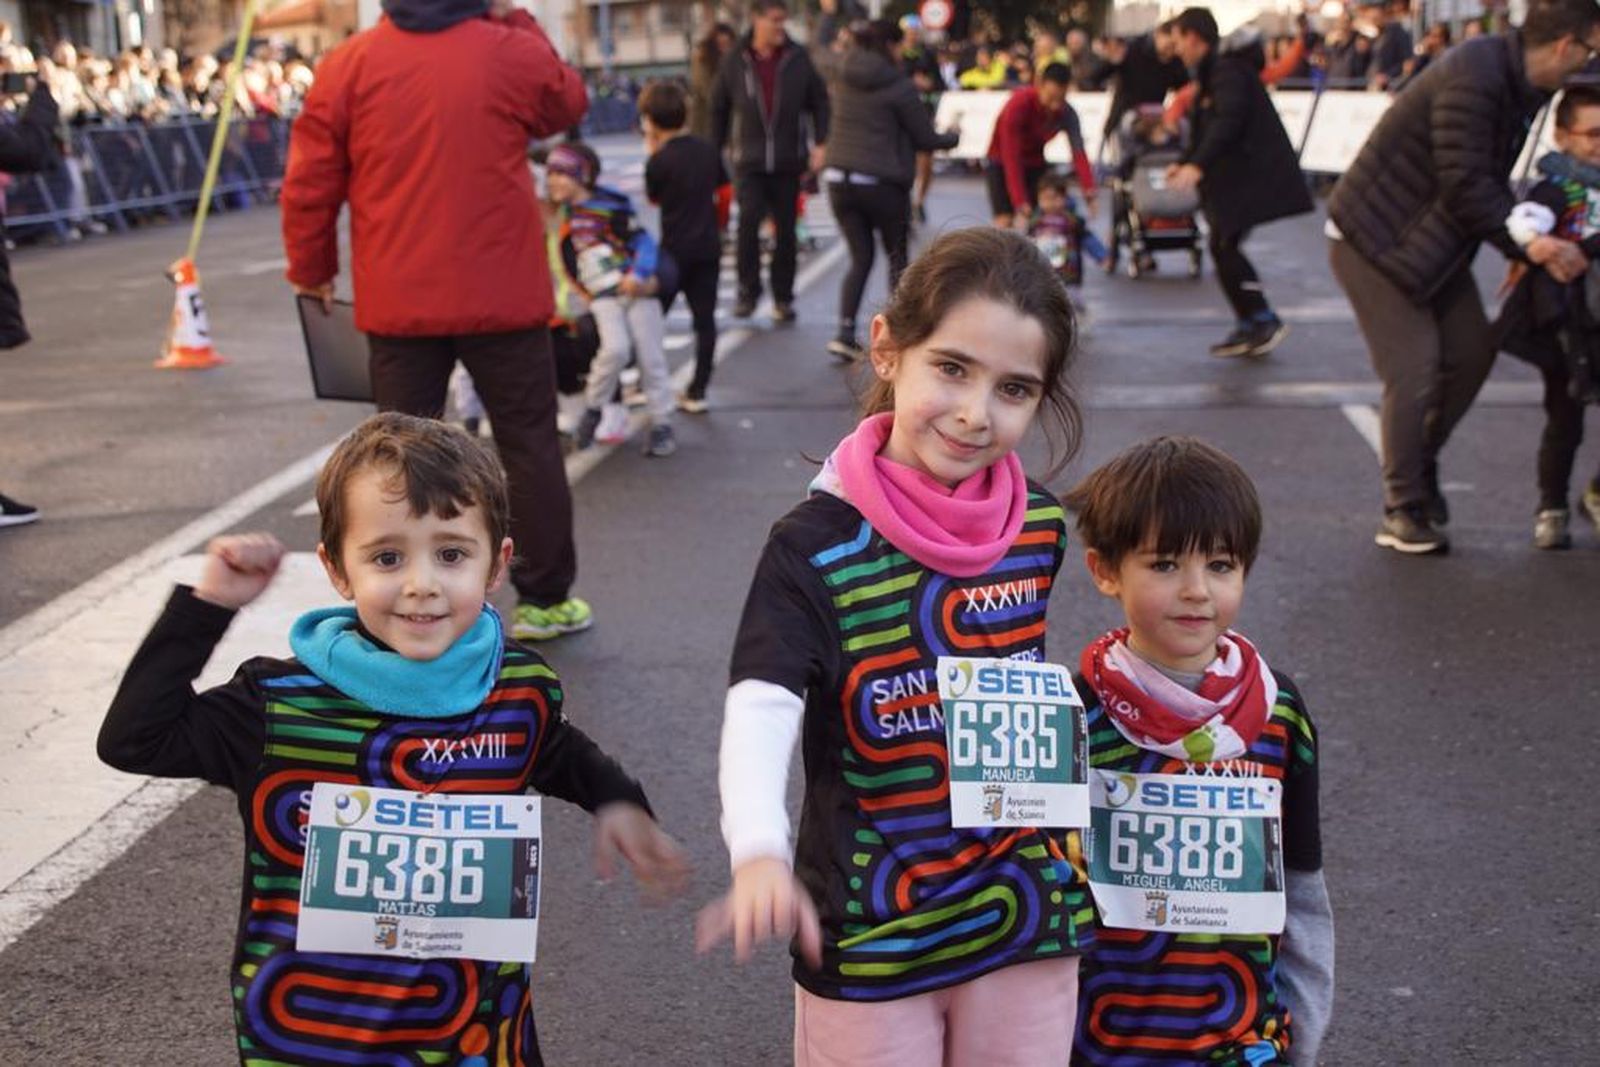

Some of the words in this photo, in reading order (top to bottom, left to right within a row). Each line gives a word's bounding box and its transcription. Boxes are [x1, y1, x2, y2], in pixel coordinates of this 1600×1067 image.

[962, 578, 1038, 613] XXXVIII
[871, 670, 928, 704] SAN
[977, 667, 1073, 698] SETEL
[952, 701, 1059, 769] 6385
[981, 766, 1035, 782] MANUELA
[1140, 781, 1265, 810] SETEL
[374, 798, 519, 831] SETEL
[1108, 812, 1244, 879] 6388
[333, 830, 485, 905] 6386
[1122, 874, 1176, 889] MIGUEL
[1183, 878, 1228, 892] ANGEL
[1171, 903, 1228, 914] Ayuntamiento
[1171, 916, 1181, 925] de
[1183, 916, 1228, 927] Salamanca
